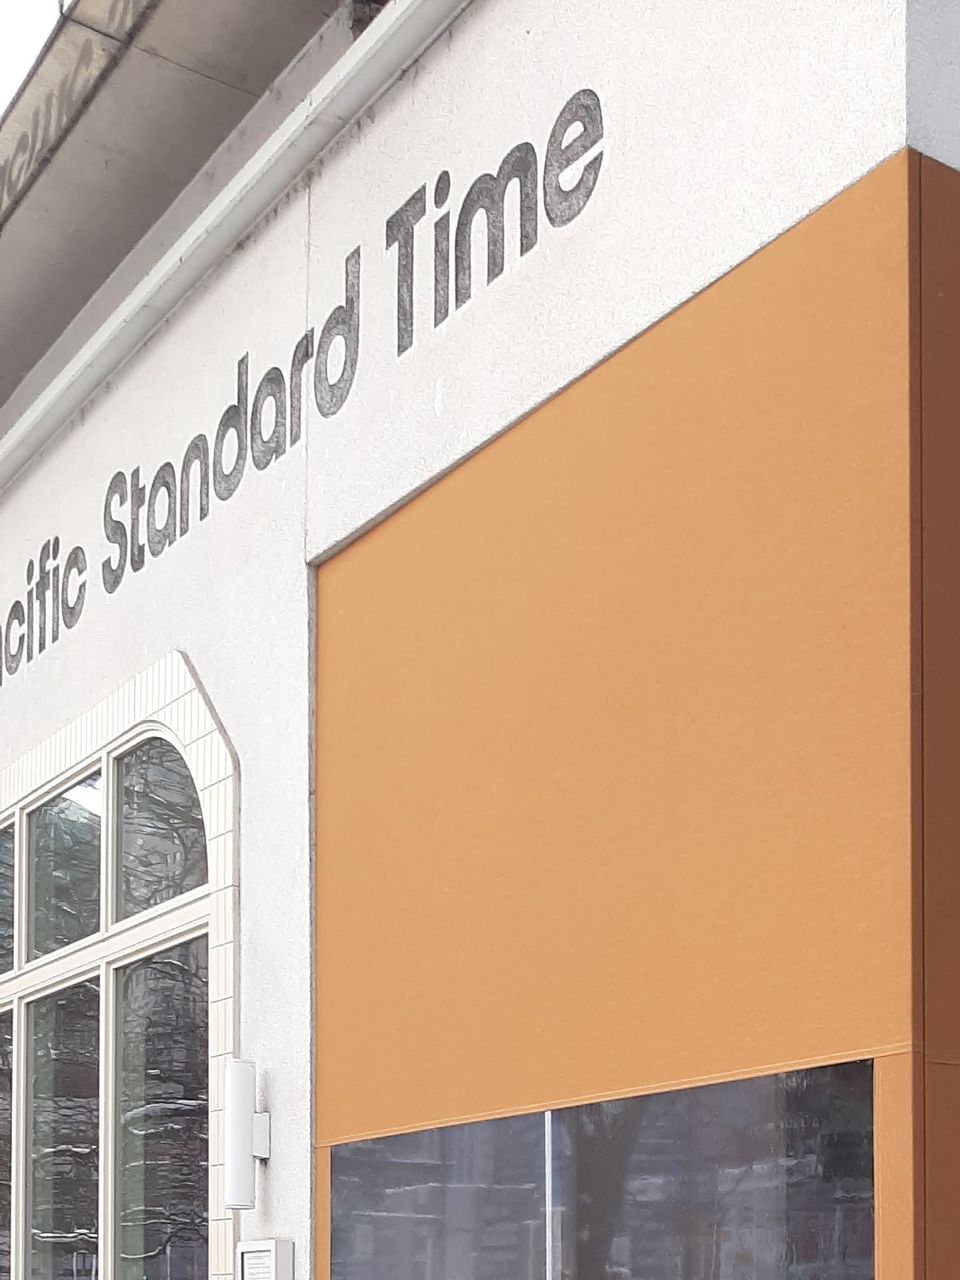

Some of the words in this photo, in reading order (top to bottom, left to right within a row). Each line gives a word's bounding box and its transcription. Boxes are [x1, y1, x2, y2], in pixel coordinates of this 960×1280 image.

[0, 535, 88, 687] cific
[102, 244, 361, 594] Standard
[385, 88, 604, 357] Time
